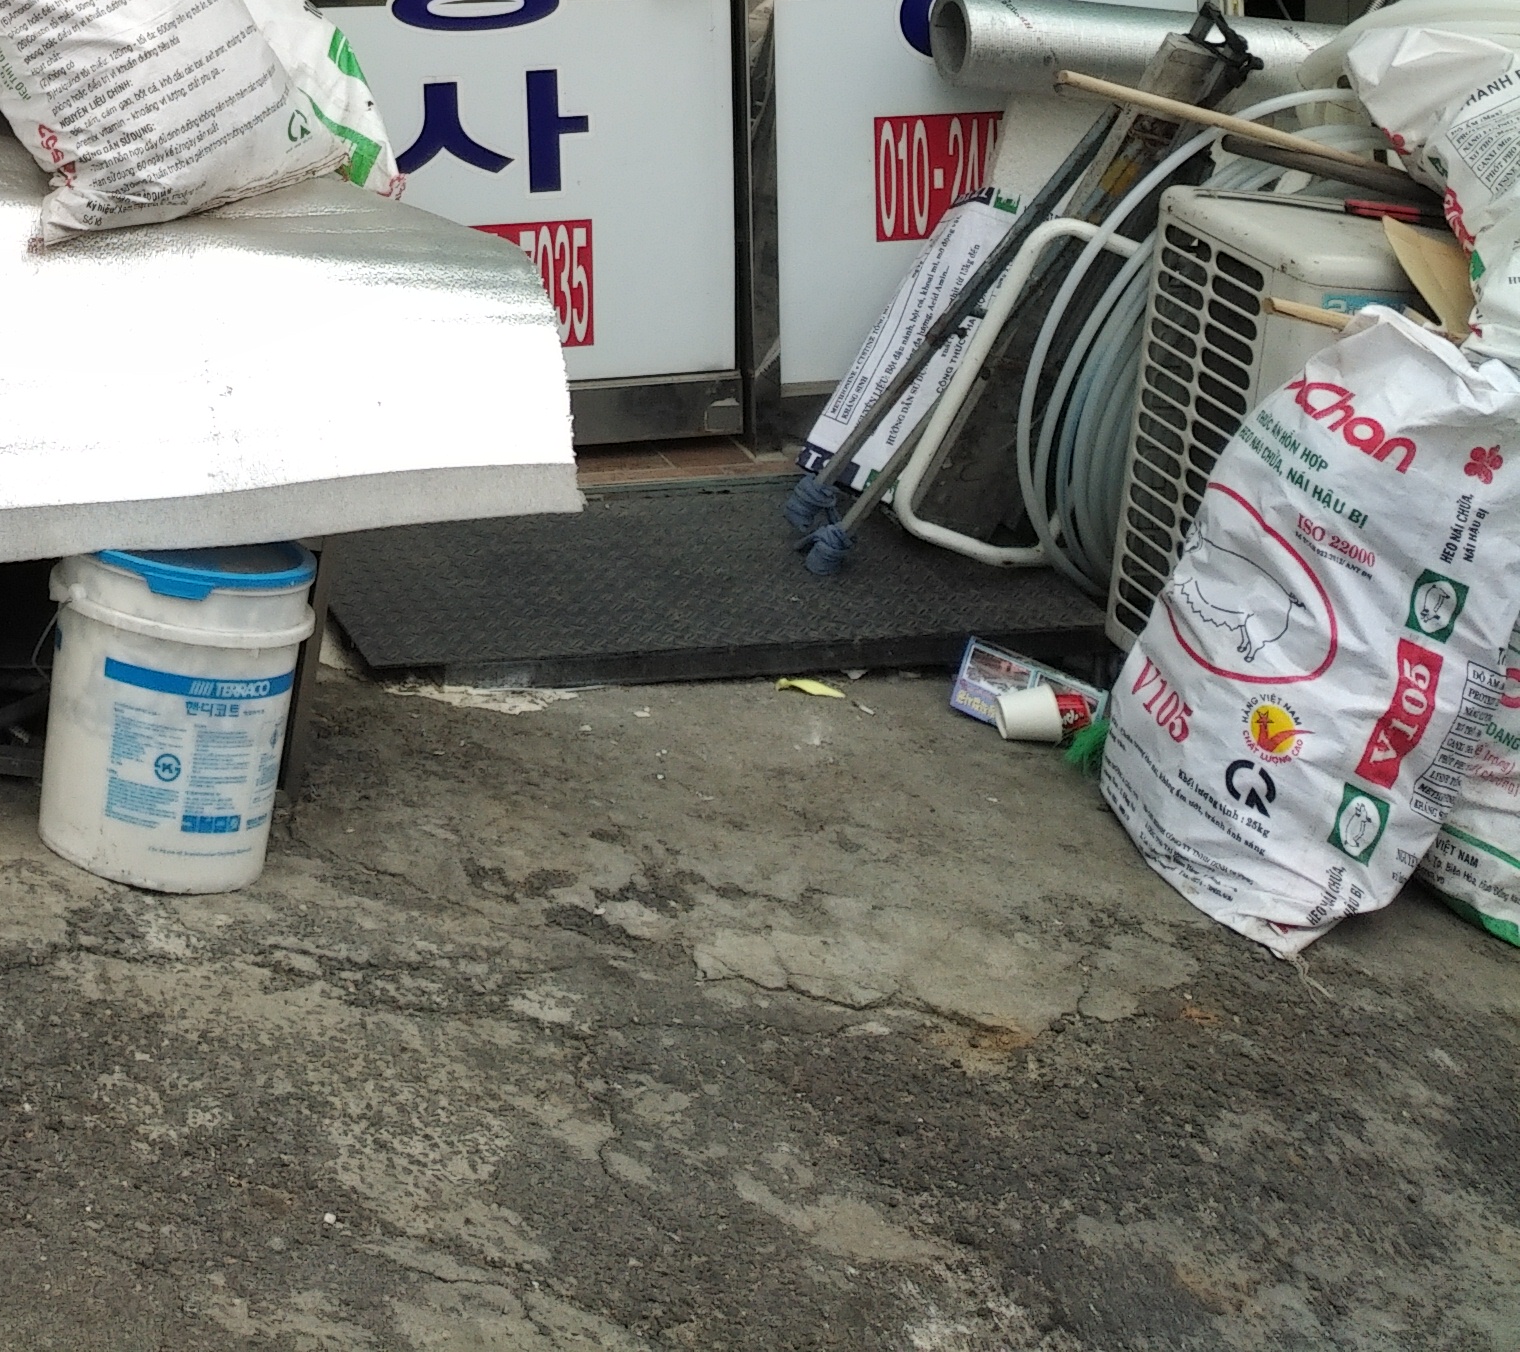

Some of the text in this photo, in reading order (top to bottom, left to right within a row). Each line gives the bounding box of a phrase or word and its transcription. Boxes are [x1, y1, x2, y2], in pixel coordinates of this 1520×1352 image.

[215, 679, 271, 697] TERRACO
[1131, 656, 1193, 744] V105
[1369, 656, 1431, 765] V105
[1458, 848, 1479, 869] NAM
